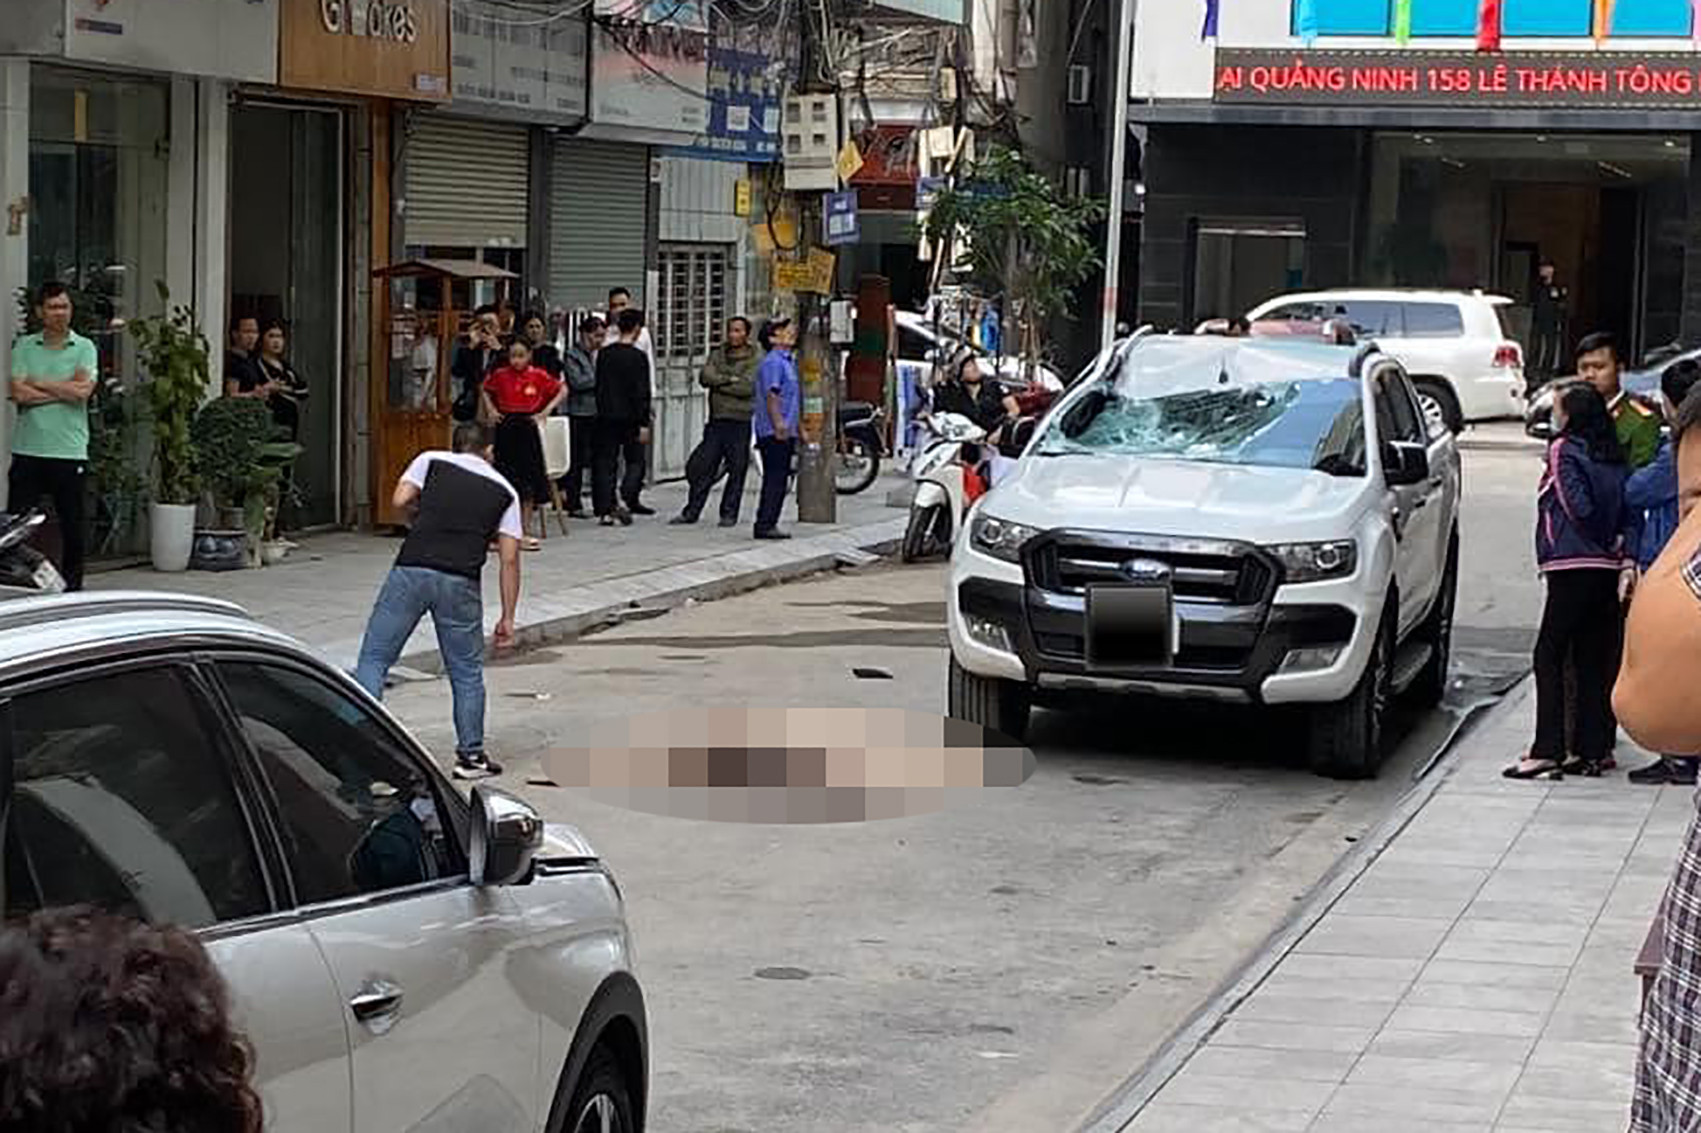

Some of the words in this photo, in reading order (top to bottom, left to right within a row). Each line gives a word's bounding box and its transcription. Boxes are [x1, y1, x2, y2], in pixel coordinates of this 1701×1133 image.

[1250, 59, 1346, 92] QUẢNG
[1352, 67, 1418, 91] NINH
[1427, 68, 1471, 92] 158
[1478, 64, 1508, 91] LÊ
[1616, 64, 1692, 94] TÔNG
